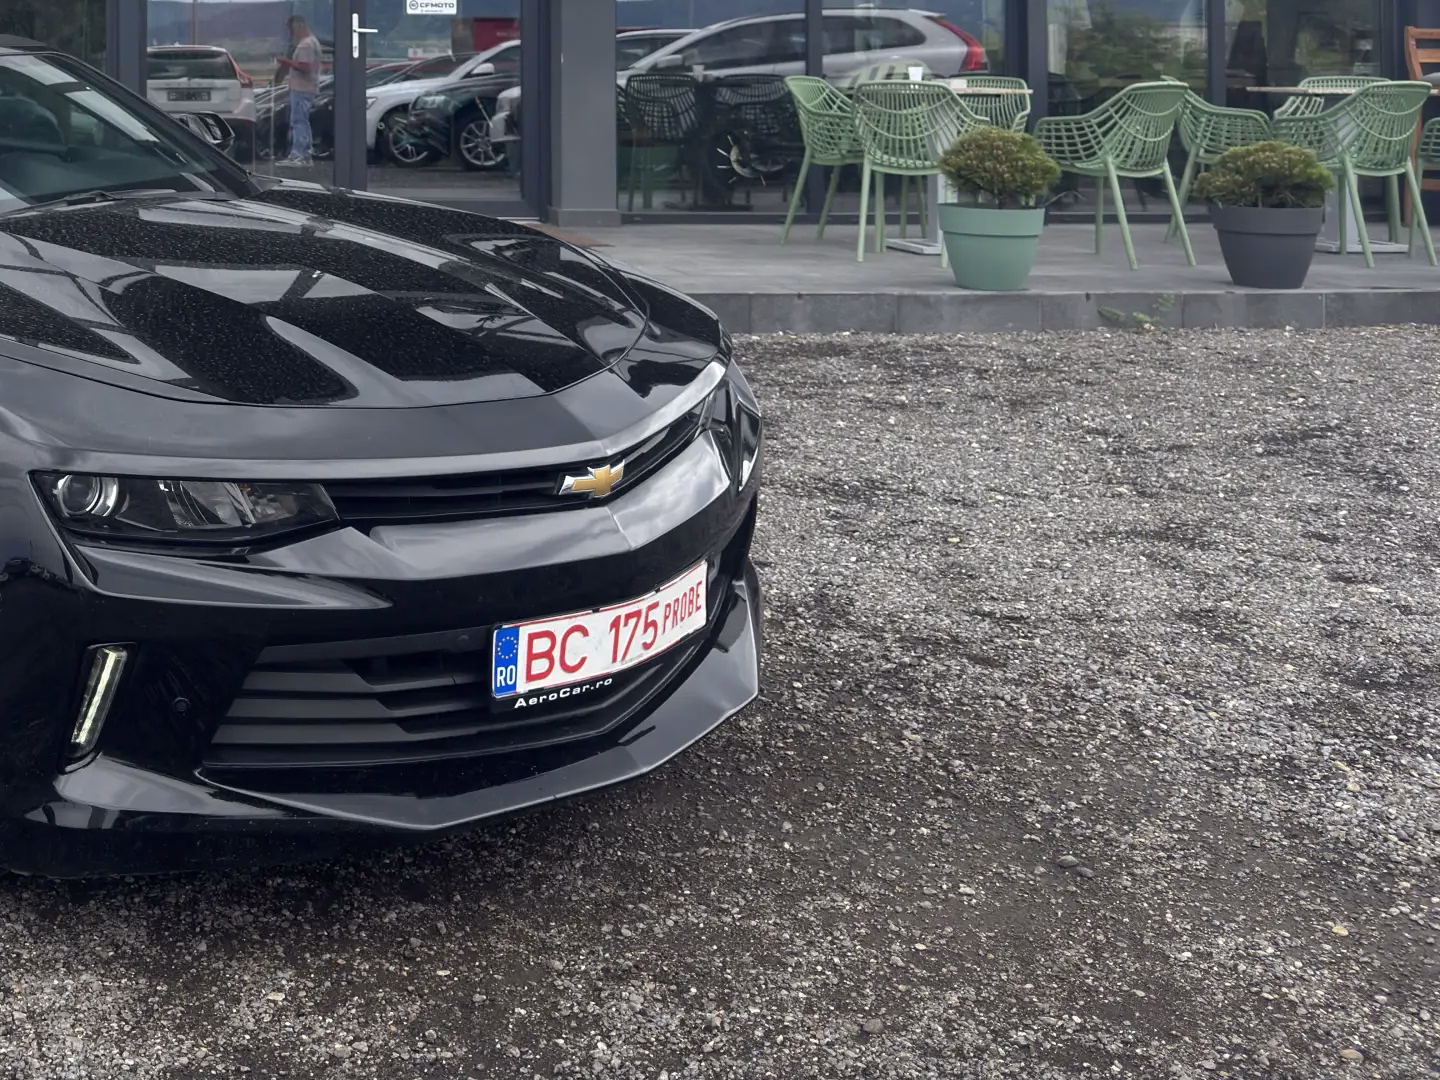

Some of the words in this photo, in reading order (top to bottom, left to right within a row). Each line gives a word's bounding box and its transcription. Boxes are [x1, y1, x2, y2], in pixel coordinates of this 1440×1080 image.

[525, 624, 589, 684] BC
[609, 602, 660, 663] 175
[662, 580, 703, 634] PROBE
[496, 665, 516, 688] RO
[514, 678, 612, 708] AeroCar.ro
